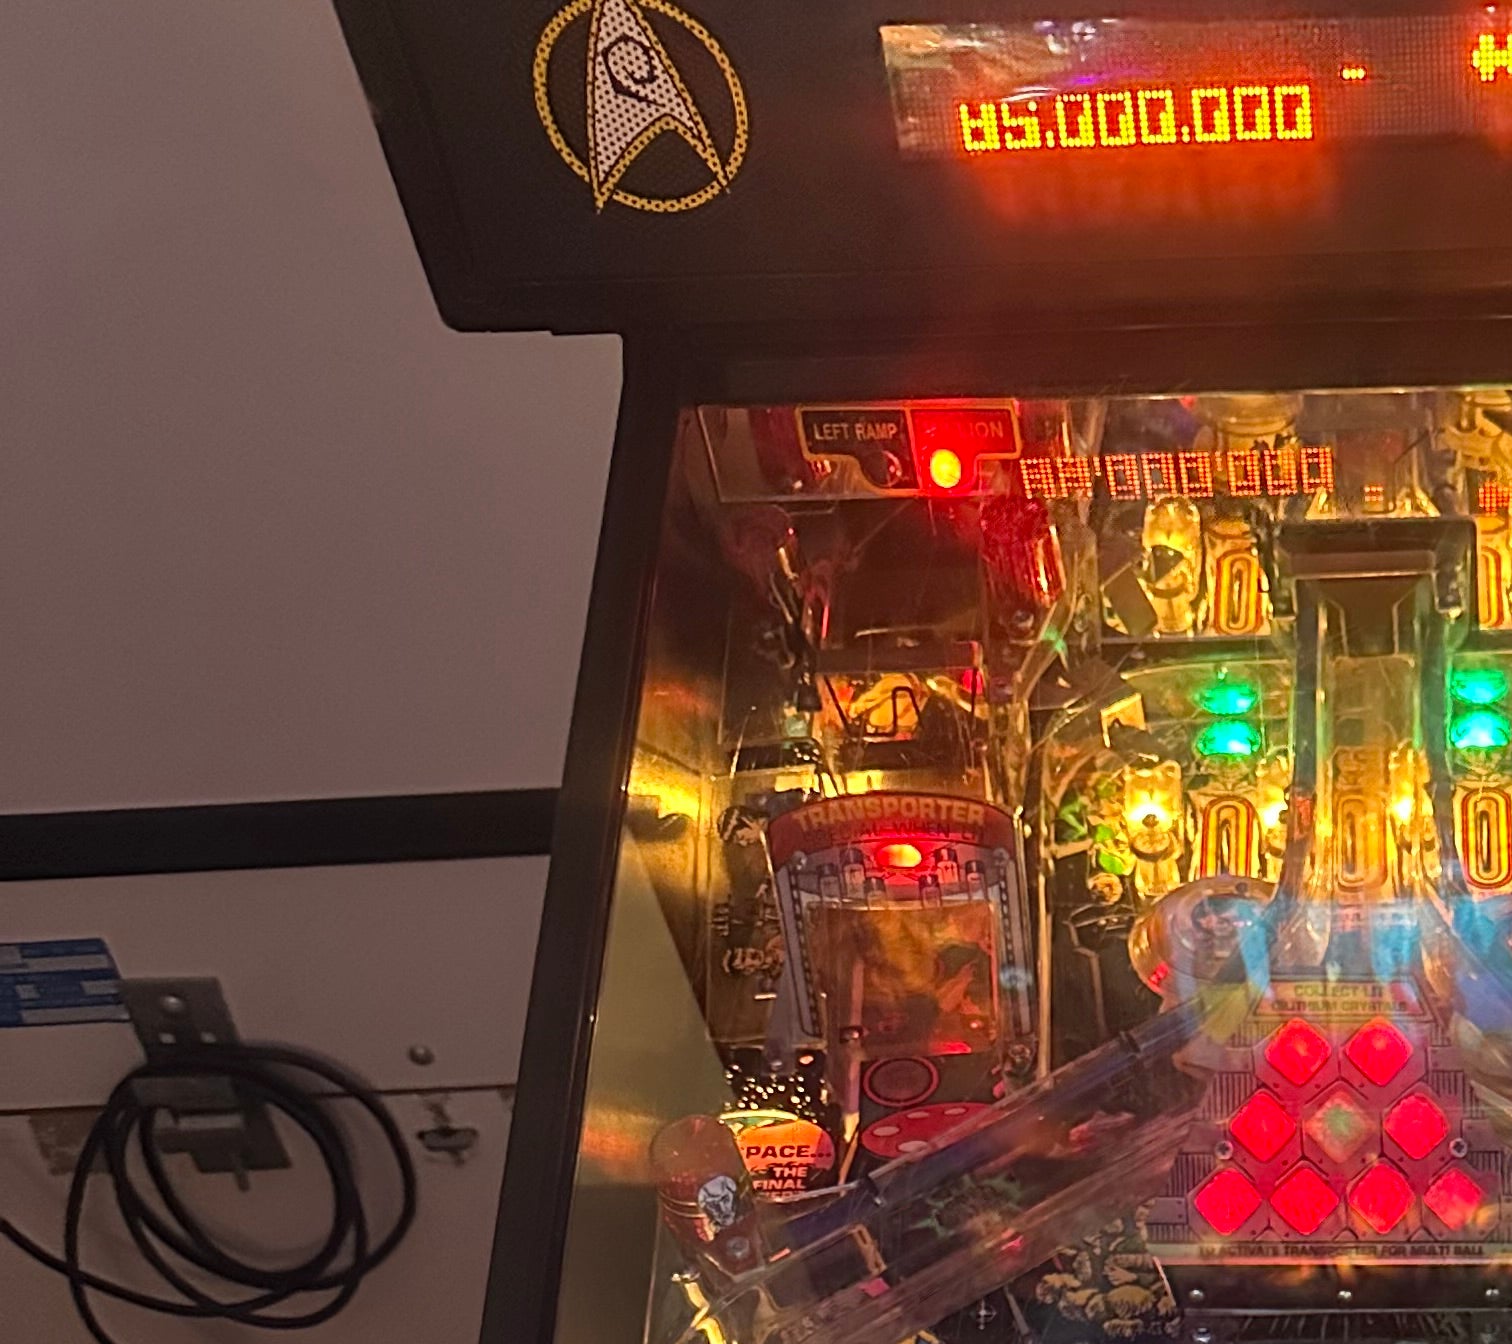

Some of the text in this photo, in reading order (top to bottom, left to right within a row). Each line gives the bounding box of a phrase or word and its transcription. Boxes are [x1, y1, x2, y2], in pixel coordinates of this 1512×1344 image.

[814, 421, 898, 441] LEFT RAMP
[792, 797, 985, 830] TRANSPORTER
[772, 1166, 808, 1178] THE
[752, 1179, 807, 1190] FINAL
